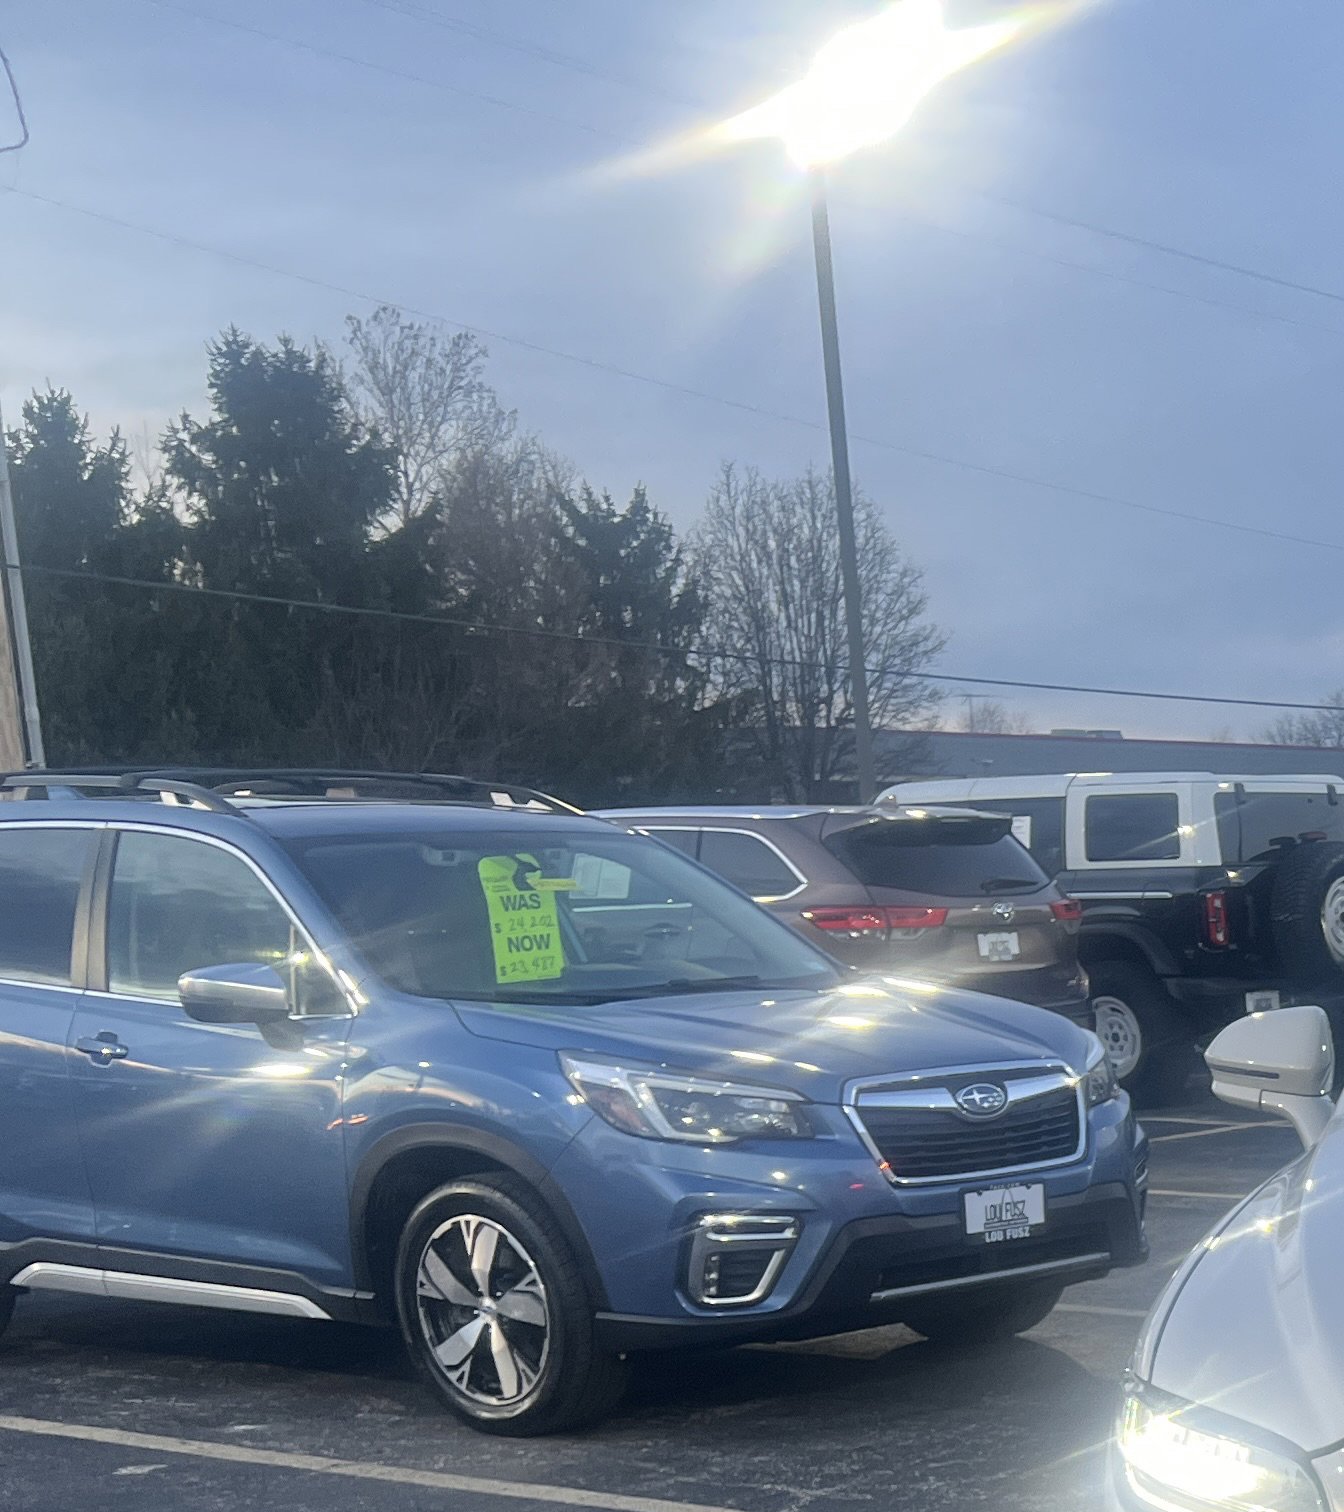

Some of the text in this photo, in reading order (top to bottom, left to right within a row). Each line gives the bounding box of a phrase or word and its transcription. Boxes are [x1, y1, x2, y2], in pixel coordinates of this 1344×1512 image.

[500, 893, 541, 912] WAS
[507, 933, 551, 953] NOW
[985, 1226, 1030, 1243] LOU FUSZ
